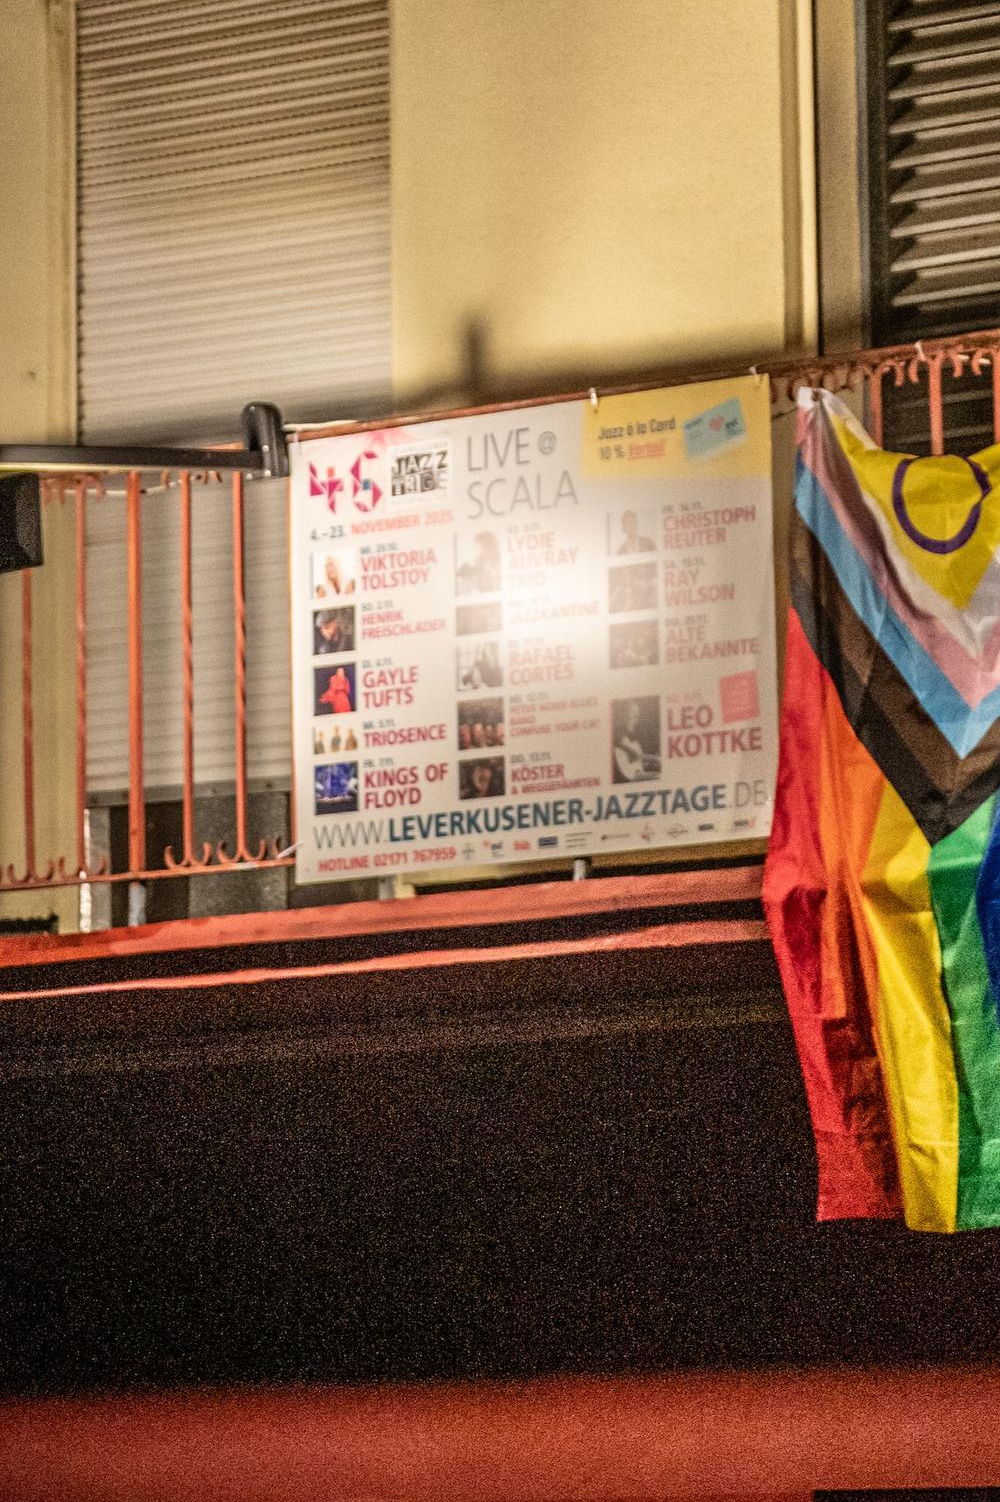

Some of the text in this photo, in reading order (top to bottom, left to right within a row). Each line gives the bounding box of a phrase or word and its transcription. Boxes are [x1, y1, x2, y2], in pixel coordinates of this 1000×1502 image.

[467, 427, 531, 472] LIVE
[538, 430, 557, 455] @
[307, 450, 384, 515] 46
[467, 469, 579, 520] SCALA
[351, 514, 421, 534] NOVEMBER
[663, 504, 757, 531] CHRISTOPH
[508, 531, 554, 553] LYDIE
[663, 527, 727, 551] REUTER
[360, 547, 437, 573] VIKTORIA
[361, 566, 430, 590] TOLSTOY
[665, 569, 699, 587] RAY
[665, 581, 736, 607] WILSON
[361, 610, 404, 625] HENRIK
[361, 619, 448, 639] FREISCHLADER
[665, 625, 706, 645] ALTE
[509, 644, 575, 667] RAFAEL
[665, 637, 760, 662] BEKANNTE
[362, 665, 419, 688] GAYLE
[363, 686, 414, 709] TUFTS
[668, 704, 713, 730] LEO
[362, 723, 447, 748] TRIOSENCE
[668, 726, 763, 758] KOTTKE
[364, 761, 449, 789] KINGS OF
[511, 763, 564, 783] KÖSTER
[363, 786, 422, 810] FLOYD
[312, 779, 769, 850] WWW.LEVERKUSENER-JAZZTAGE.DE
[317, 855, 369, 873] HOTLINE
